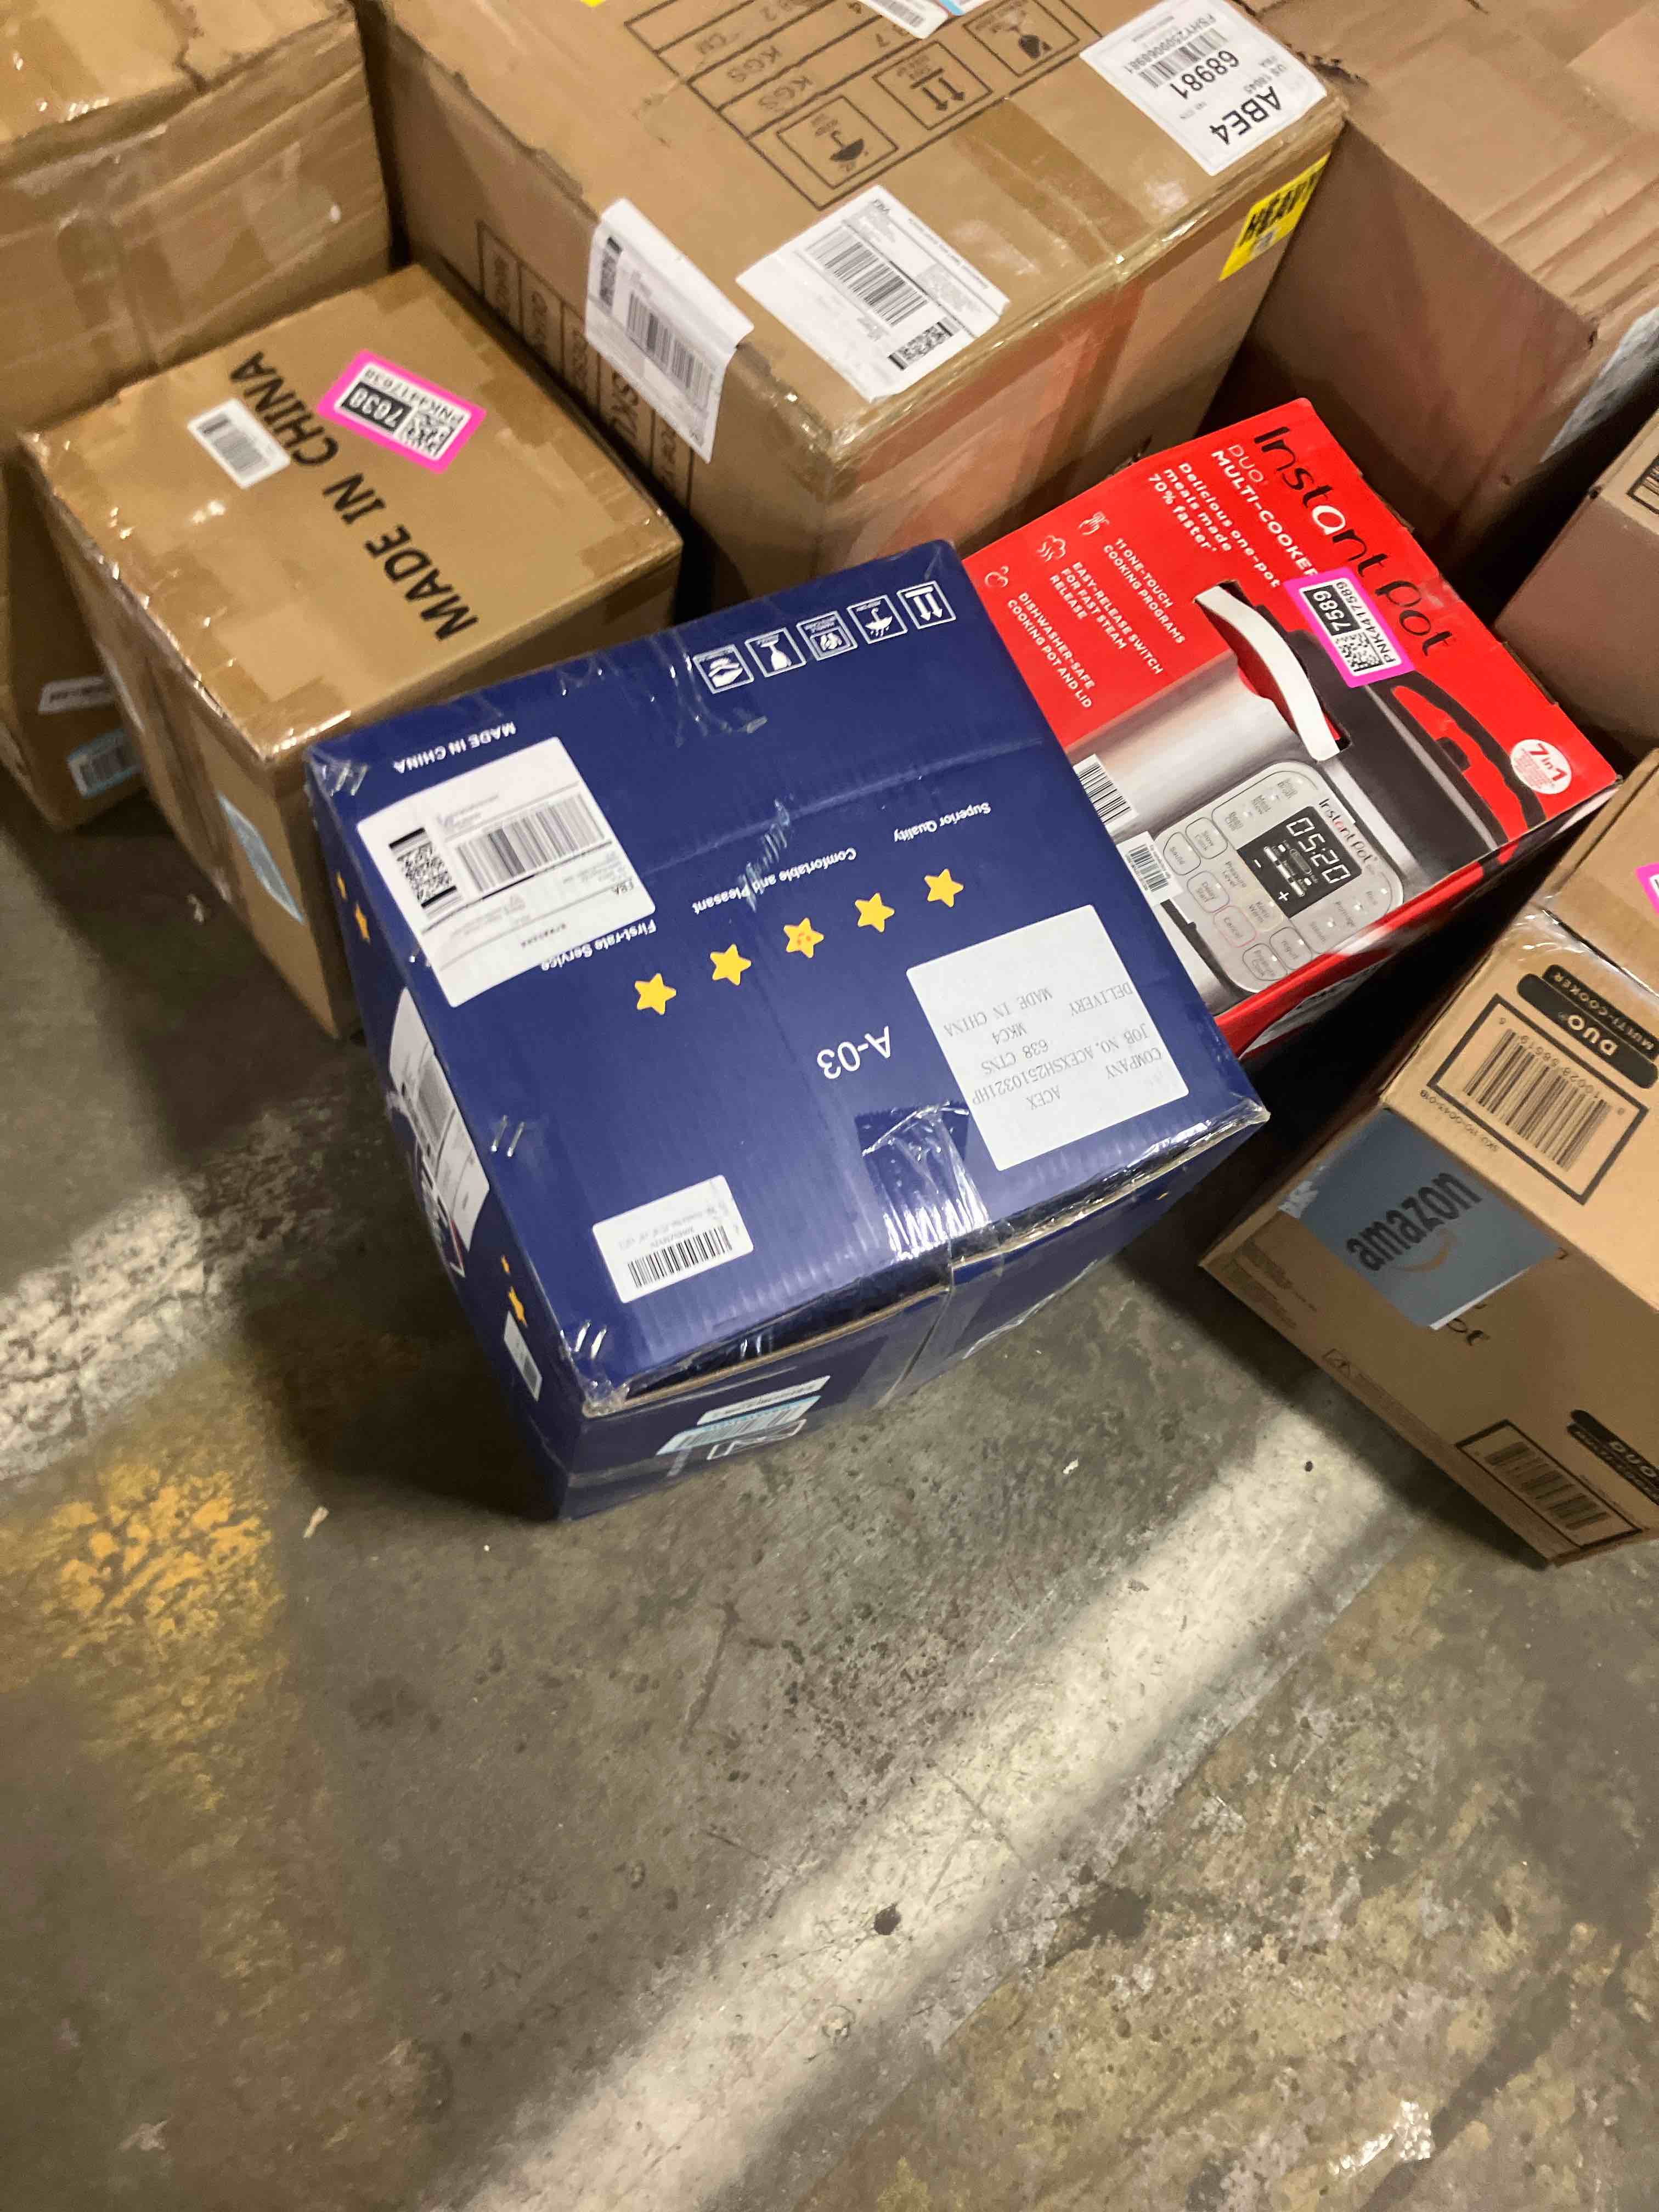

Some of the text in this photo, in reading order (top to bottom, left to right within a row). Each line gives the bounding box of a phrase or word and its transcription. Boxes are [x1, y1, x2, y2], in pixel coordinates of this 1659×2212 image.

[726, 45, 783, 83] KGS
[757, 75, 814, 111] KGS
[1171, 49, 1239, 99] 68981
[1209, 85, 1283, 145] ABE4
[229, 351, 479, 641] MADE IN CHINA
[1148, 473, 1176, 505] 70%
[1164, 469, 1232, 551] meals made
[1253, 425, 1390, 579] Instant
[1178, 462, 1280, 588] Delicious one-pot
[1049, 575, 1088, 620] RELEASE
[1103, 544, 1186, 644] COOKING PROGRAMS
[1114, 537, 1173, 609] 11 ONE-TOUCH
[1060, 567, 1127, 650] FOR FAST STEAM
[1072, 561, 1164, 675] EASY-RELEASE SWITCH
[1312, 589, 1352, 633] 7589
[1335, 580, 1397, 665] PNK4417589
[1007, 599, 1092, 708] COOKING POT AND LID
[1018, 592, 1096, 690] DISHWASHER-SAFE
[393, 721, 517, 775] MADE IN CHINA
[893, 802, 992, 843] Superior Quality
[1286, 817, 1351, 884] 05:20
[1318, 798, 1356, 842] Instant
[692, 848, 857, 915] Comfortable and Pleasant
[540, 940, 593, 972] Service
[592, 919, 657, 953] First-rate
[943, 987, 1053, 1037] MADE IN CHINA
[992, 981, 1134, 1046] DELIVERY MKC4
[1124, 1023, 1150, 1045] JOB
[1551, 970, 1656, 1052] MULTI-COOKER
[1567, 1013, 1619, 1057] DUO
[816, 1025, 893, 1080] A-03
[980, 1052, 1017, 1076] CTNS
[1026, 1047, 1163, 1111] COMPANY ACEX
[1346, 1172, 1483, 1272] amazon
